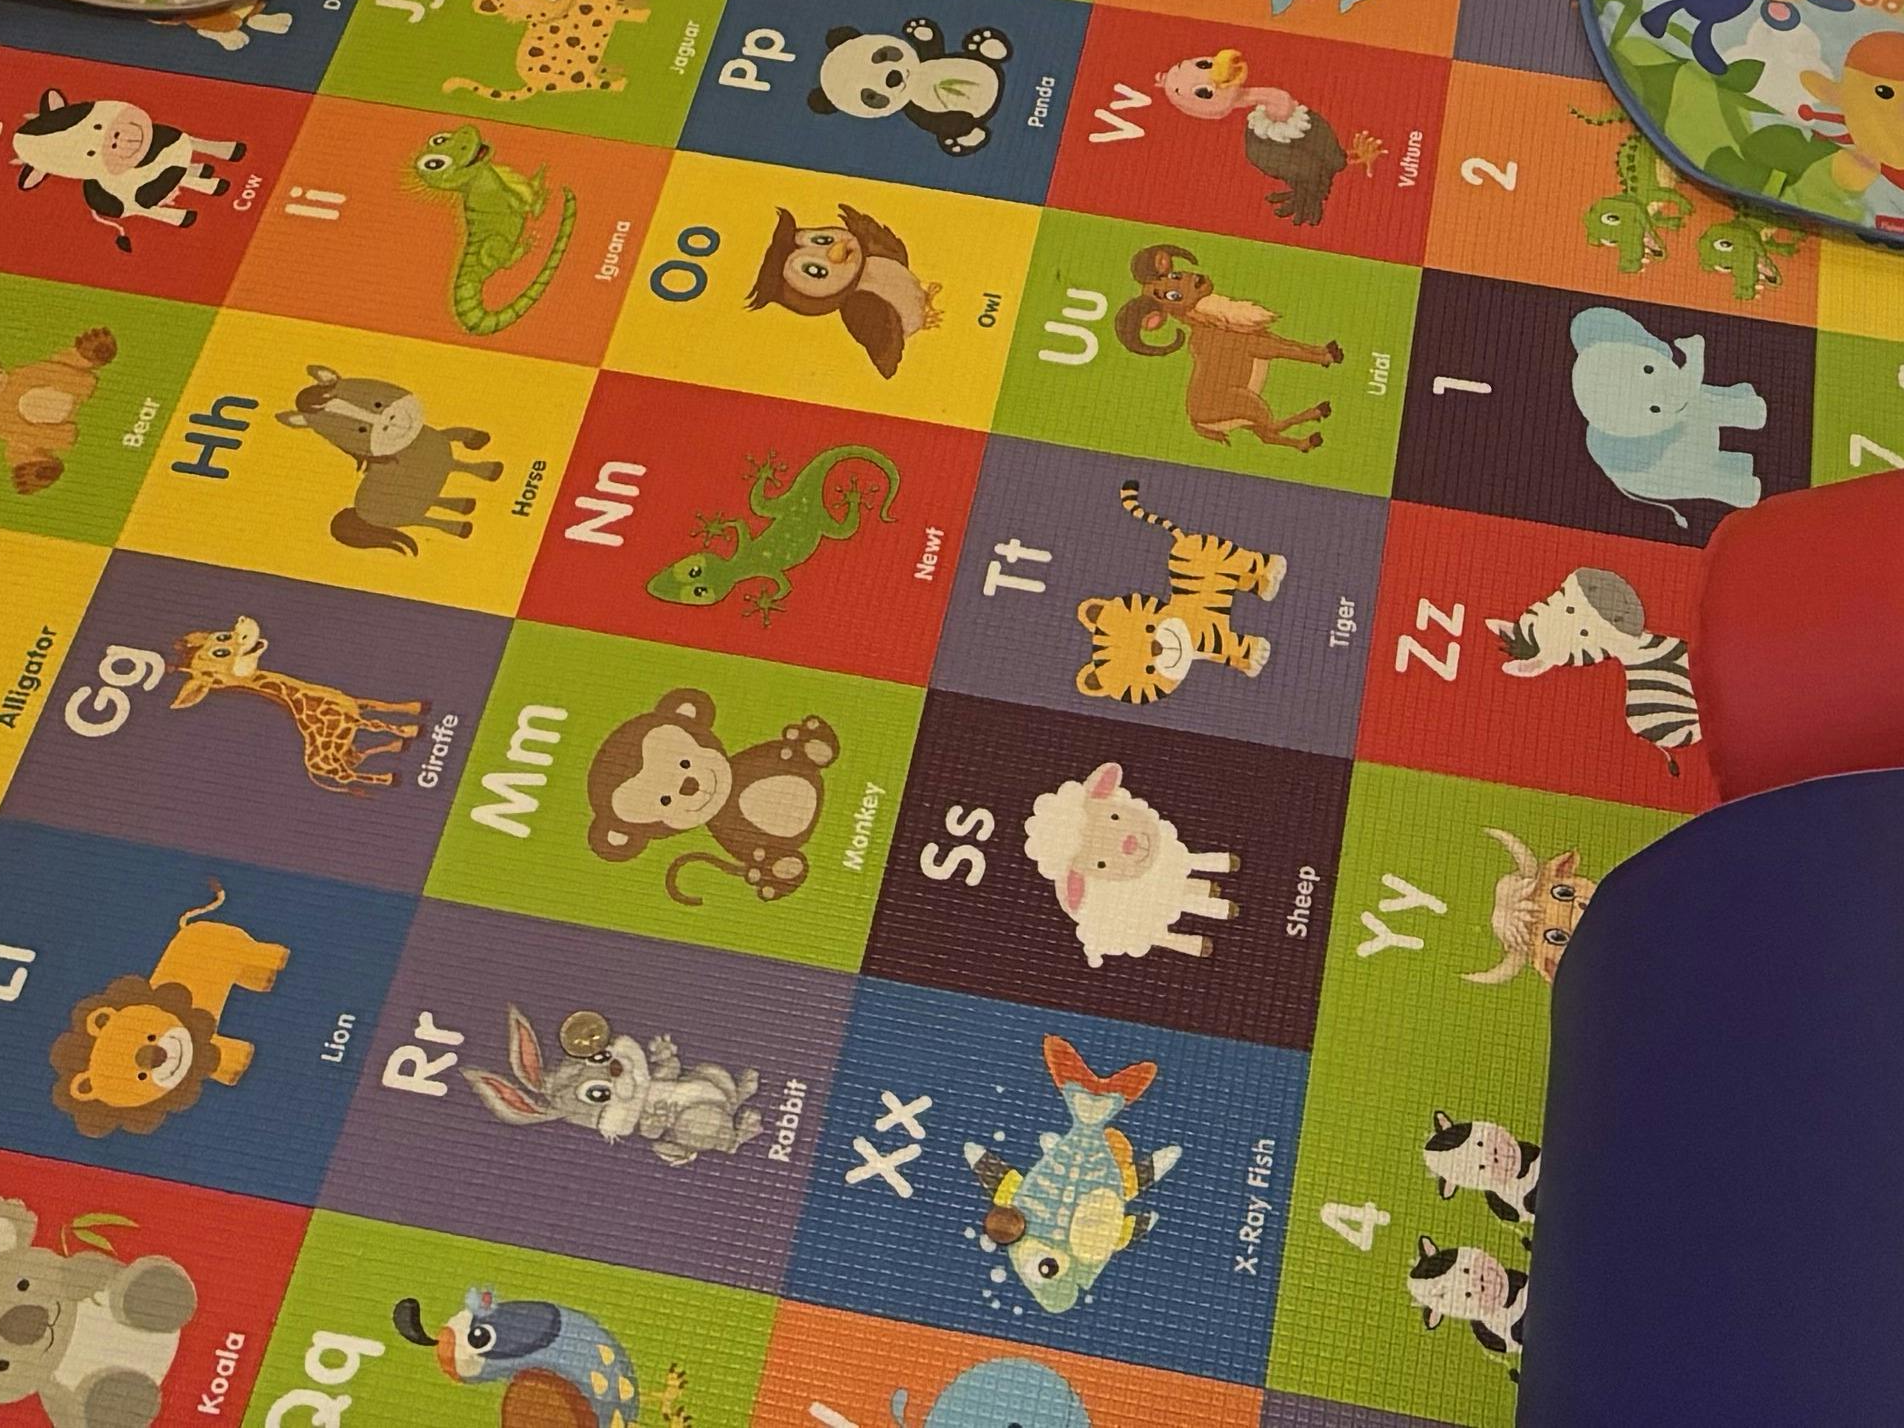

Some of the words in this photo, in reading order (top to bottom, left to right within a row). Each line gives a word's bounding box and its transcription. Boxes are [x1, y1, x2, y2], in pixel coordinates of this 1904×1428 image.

[669, 20, 702, 76] Jaguar
[717, 25, 797, 93] Pp
[1027, 75, 1055, 129] Panda
[1088, 82, 1154, 144] Vv
[1398, 130, 1423, 188] Vulture
[1460, 157, 1518, 191] 2
[233, 172, 263, 213] Cow
[285, 186, 347, 221] Ii
[594, 219, 632, 284] Iguana
[649, 225, 721, 302] Oo
[977, 291, 1003, 329] Owl
[1038, 286, 1109, 366] Uu
[1366, 351, 1391, 398] Urial
[1432, 376, 1492, 396] 1
[122, 395, 163, 450] Bear
[170, 390, 261, 480] Hh
[511, 458, 548, 518] Horse
[564, 458, 648, 548] Nn
[914, 526, 945, 582] Newt
[982, 537, 1053, 598] Tt
[1328, 595, 1357, 650] Tiger
[1394, 597, 1466, 682] Zz
[65, 642, 166, 739] Gg
[417, 711, 460, 792] Giraffe
[470, 703, 568, 839] Mm
[842, 781, 886, 873] Monkey
[919, 803, 996, 888] Ss
[1286, 865, 1317, 939] Sheep
[1356, 873, 1447, 958] Yy
[320, 1010, 356, 1064] Lion
[382, 1009, 466, 1098] Rr
[768, 1076, 808, 1163] Rabbit
[844, 1090, 933, 1199] Xx
[1247, 1138, 1275, 1178] Fish
[1235, 1185, 1270, 1276] X-Ray
[1321, 1201, 1391, 1252] 4
[198, 1332, 246, 1415] Koala
